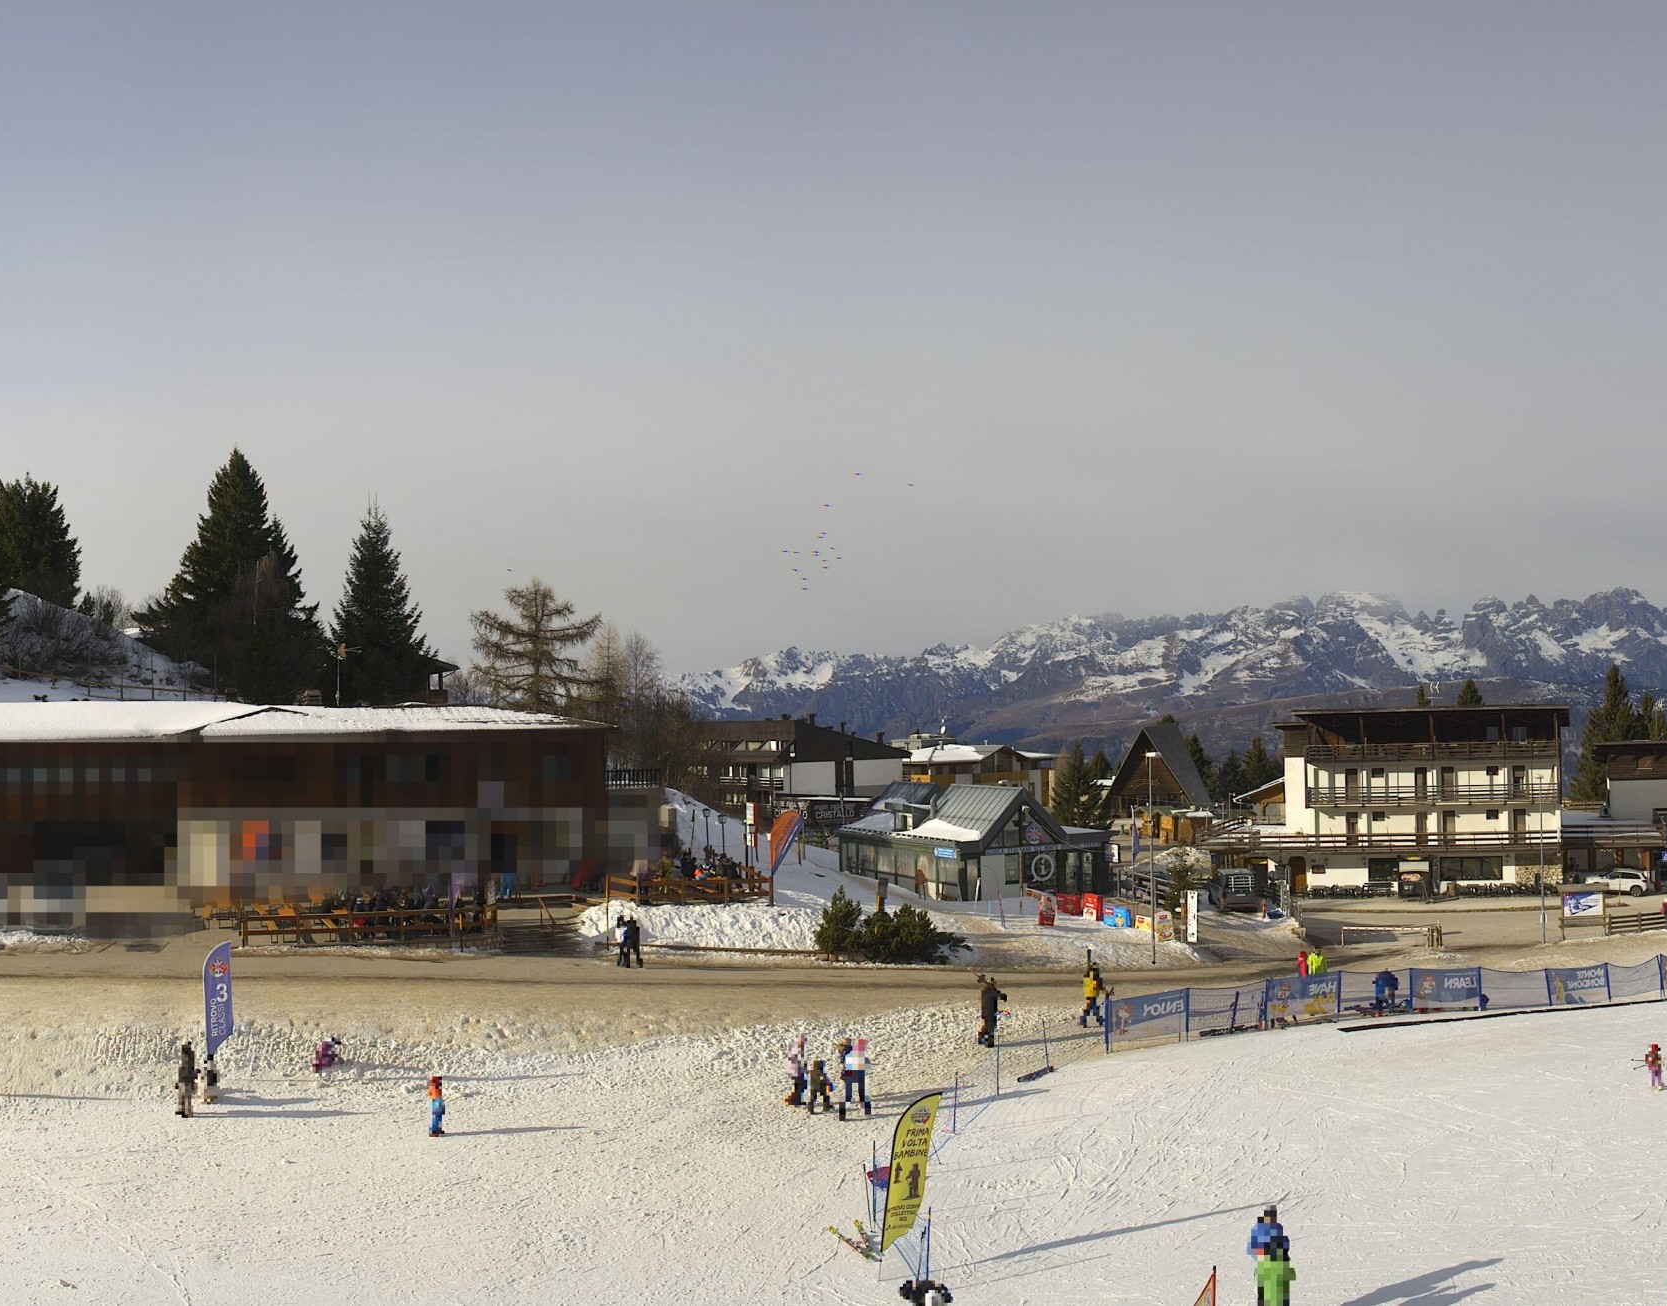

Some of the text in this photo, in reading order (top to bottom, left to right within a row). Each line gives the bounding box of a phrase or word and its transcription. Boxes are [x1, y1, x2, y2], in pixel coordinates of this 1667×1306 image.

[815, 809, 855, 820] CRISTALLO
[216, 983, 228, 1003] 3
[210, 998, 218, 1037] RITROVO
[217, 1004, 226, 1035] CLASSI
[906, 1127, 929, 1138] PRIMA
[902, 1138, 928, 1148] VOLTA
